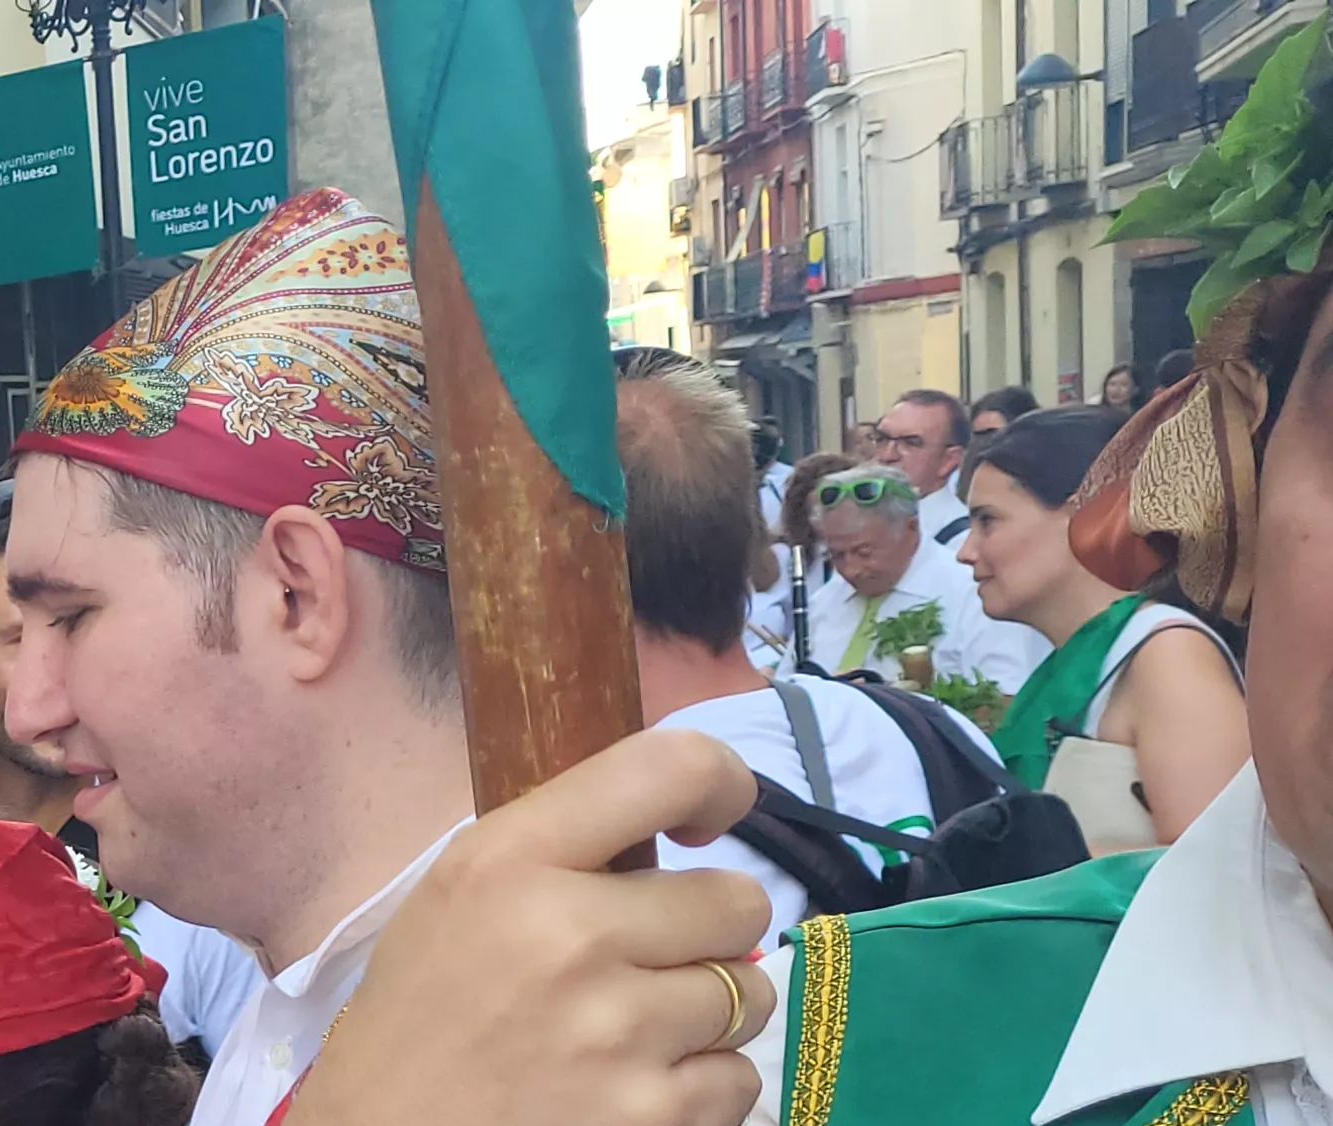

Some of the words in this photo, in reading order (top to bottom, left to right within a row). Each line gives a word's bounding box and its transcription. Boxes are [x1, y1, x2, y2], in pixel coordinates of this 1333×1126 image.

[143, 76, 204, 112] vive
[146, 113, 207, 147] San
[12, 164, 58, 183] Huesca
[149, 137, 275, 183] Lorenzo
[151, 206, 191, 222] fiestas
[193, 202, 209, 215] de
[164, 219, 210, 236] Huesca
